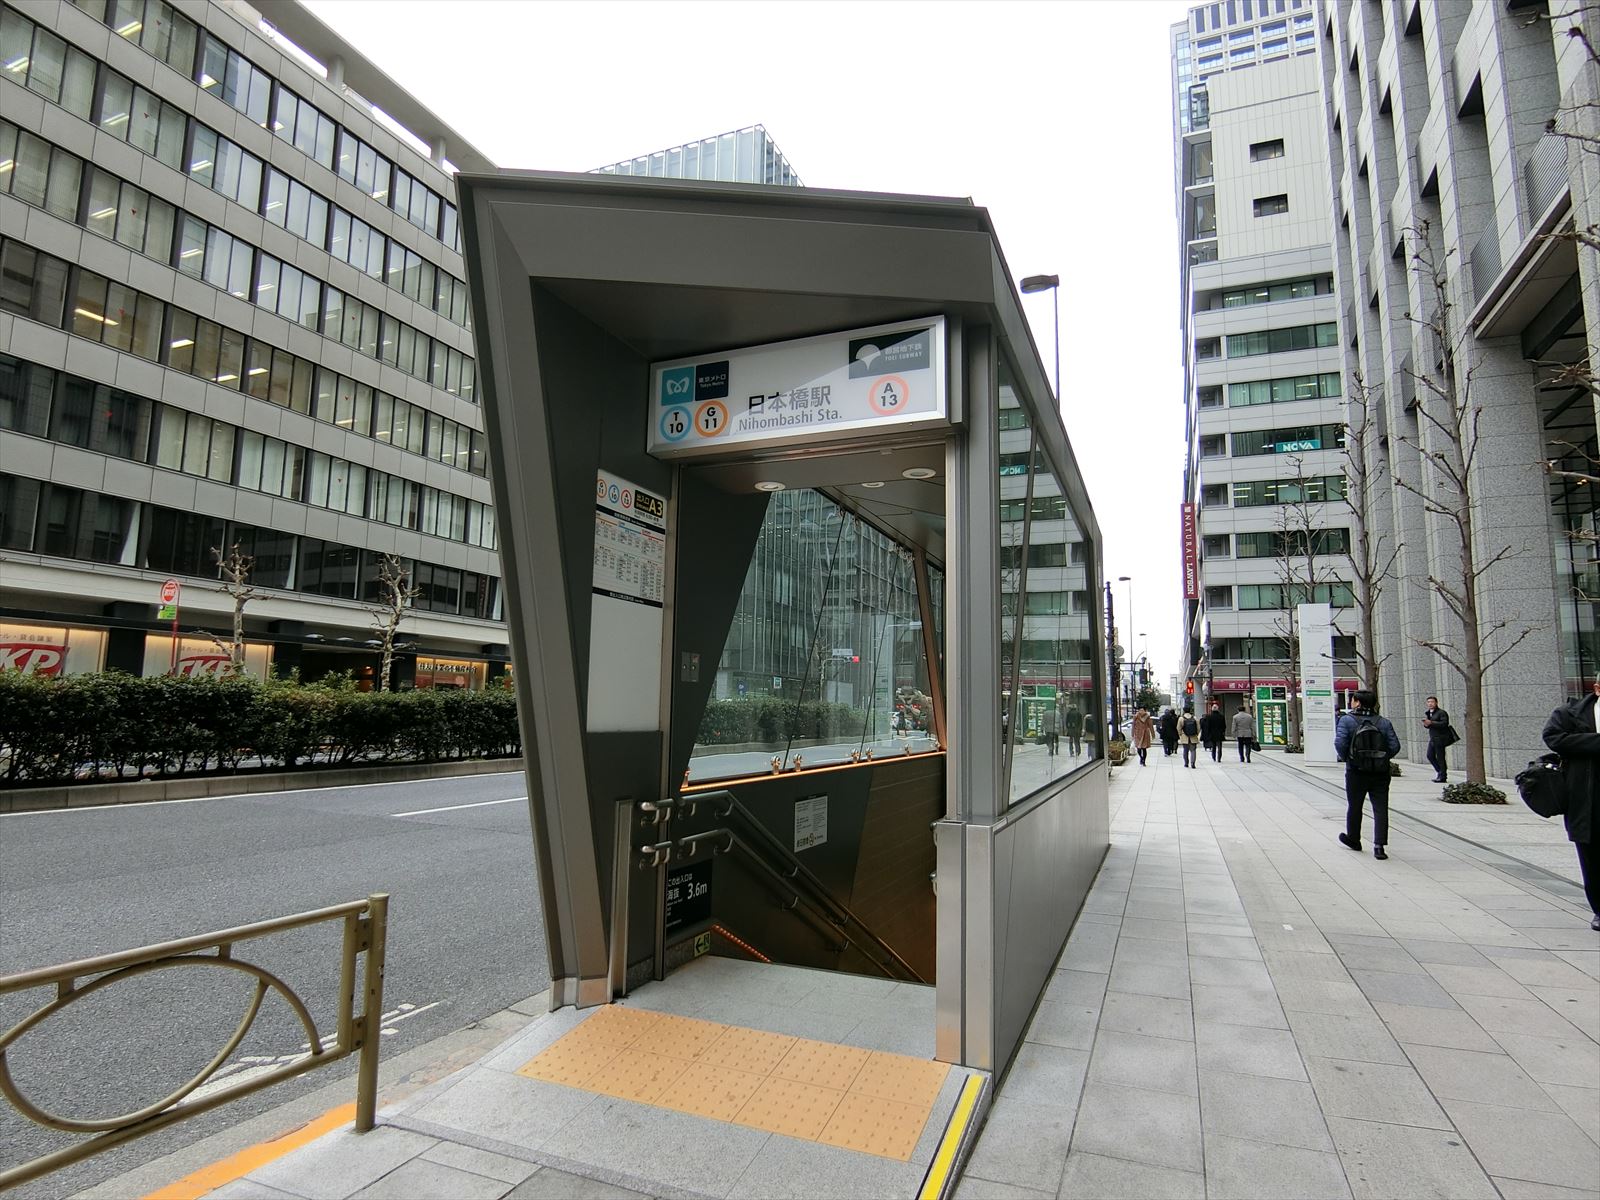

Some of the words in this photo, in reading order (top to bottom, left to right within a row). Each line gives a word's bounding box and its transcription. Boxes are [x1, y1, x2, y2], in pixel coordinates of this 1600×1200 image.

[883, 382, 894, 394] A
[748, 385, 831, 416] 日本橋駅
[881, 394, 898, 407] 13
[673, 411, 679, 421] T
[706, 406, 716, 417] G
[704, 417, 717, 430] 11
[739, 409, 813, 431] Nihombashi
[817, 408, 842, 422] Sta.
[669, 422, 684, 434] 10
[1282, 441, 1315, 451] NOVA
[649, 499, 663, 517] A3
[1184, 515, 1193, 560] NATURAL
[687, 882, 708, 900] 3.6m
